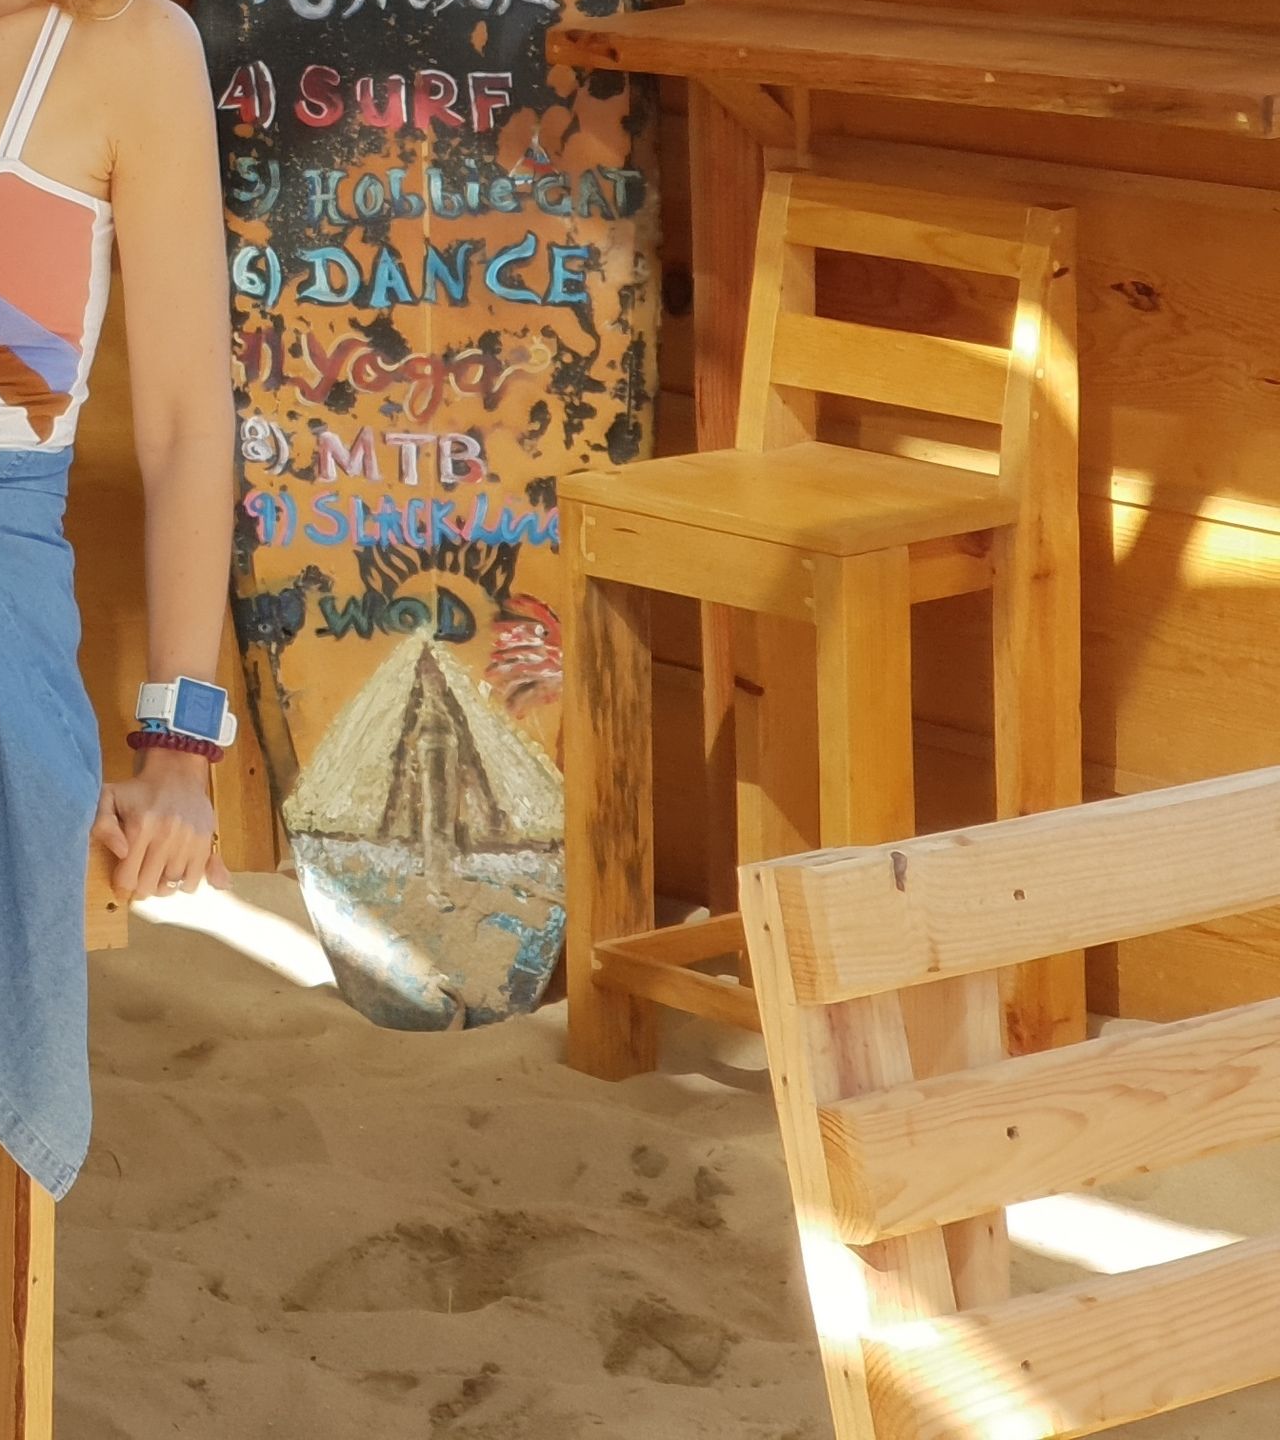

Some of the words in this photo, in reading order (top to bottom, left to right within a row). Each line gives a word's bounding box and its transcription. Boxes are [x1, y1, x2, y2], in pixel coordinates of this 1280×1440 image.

[217, 60, 277, 130] 4)
[294, 63, 513, 134] SURF
[231, 156, 281, 218] 5)
[231, 245, 283, 308] 6)
[296, 230, 592, 309] DANCE
[240, 414, 290, 476] 8)
[315, 425, 488, 487] MTB
[242, 489, 298, 547] 9)
